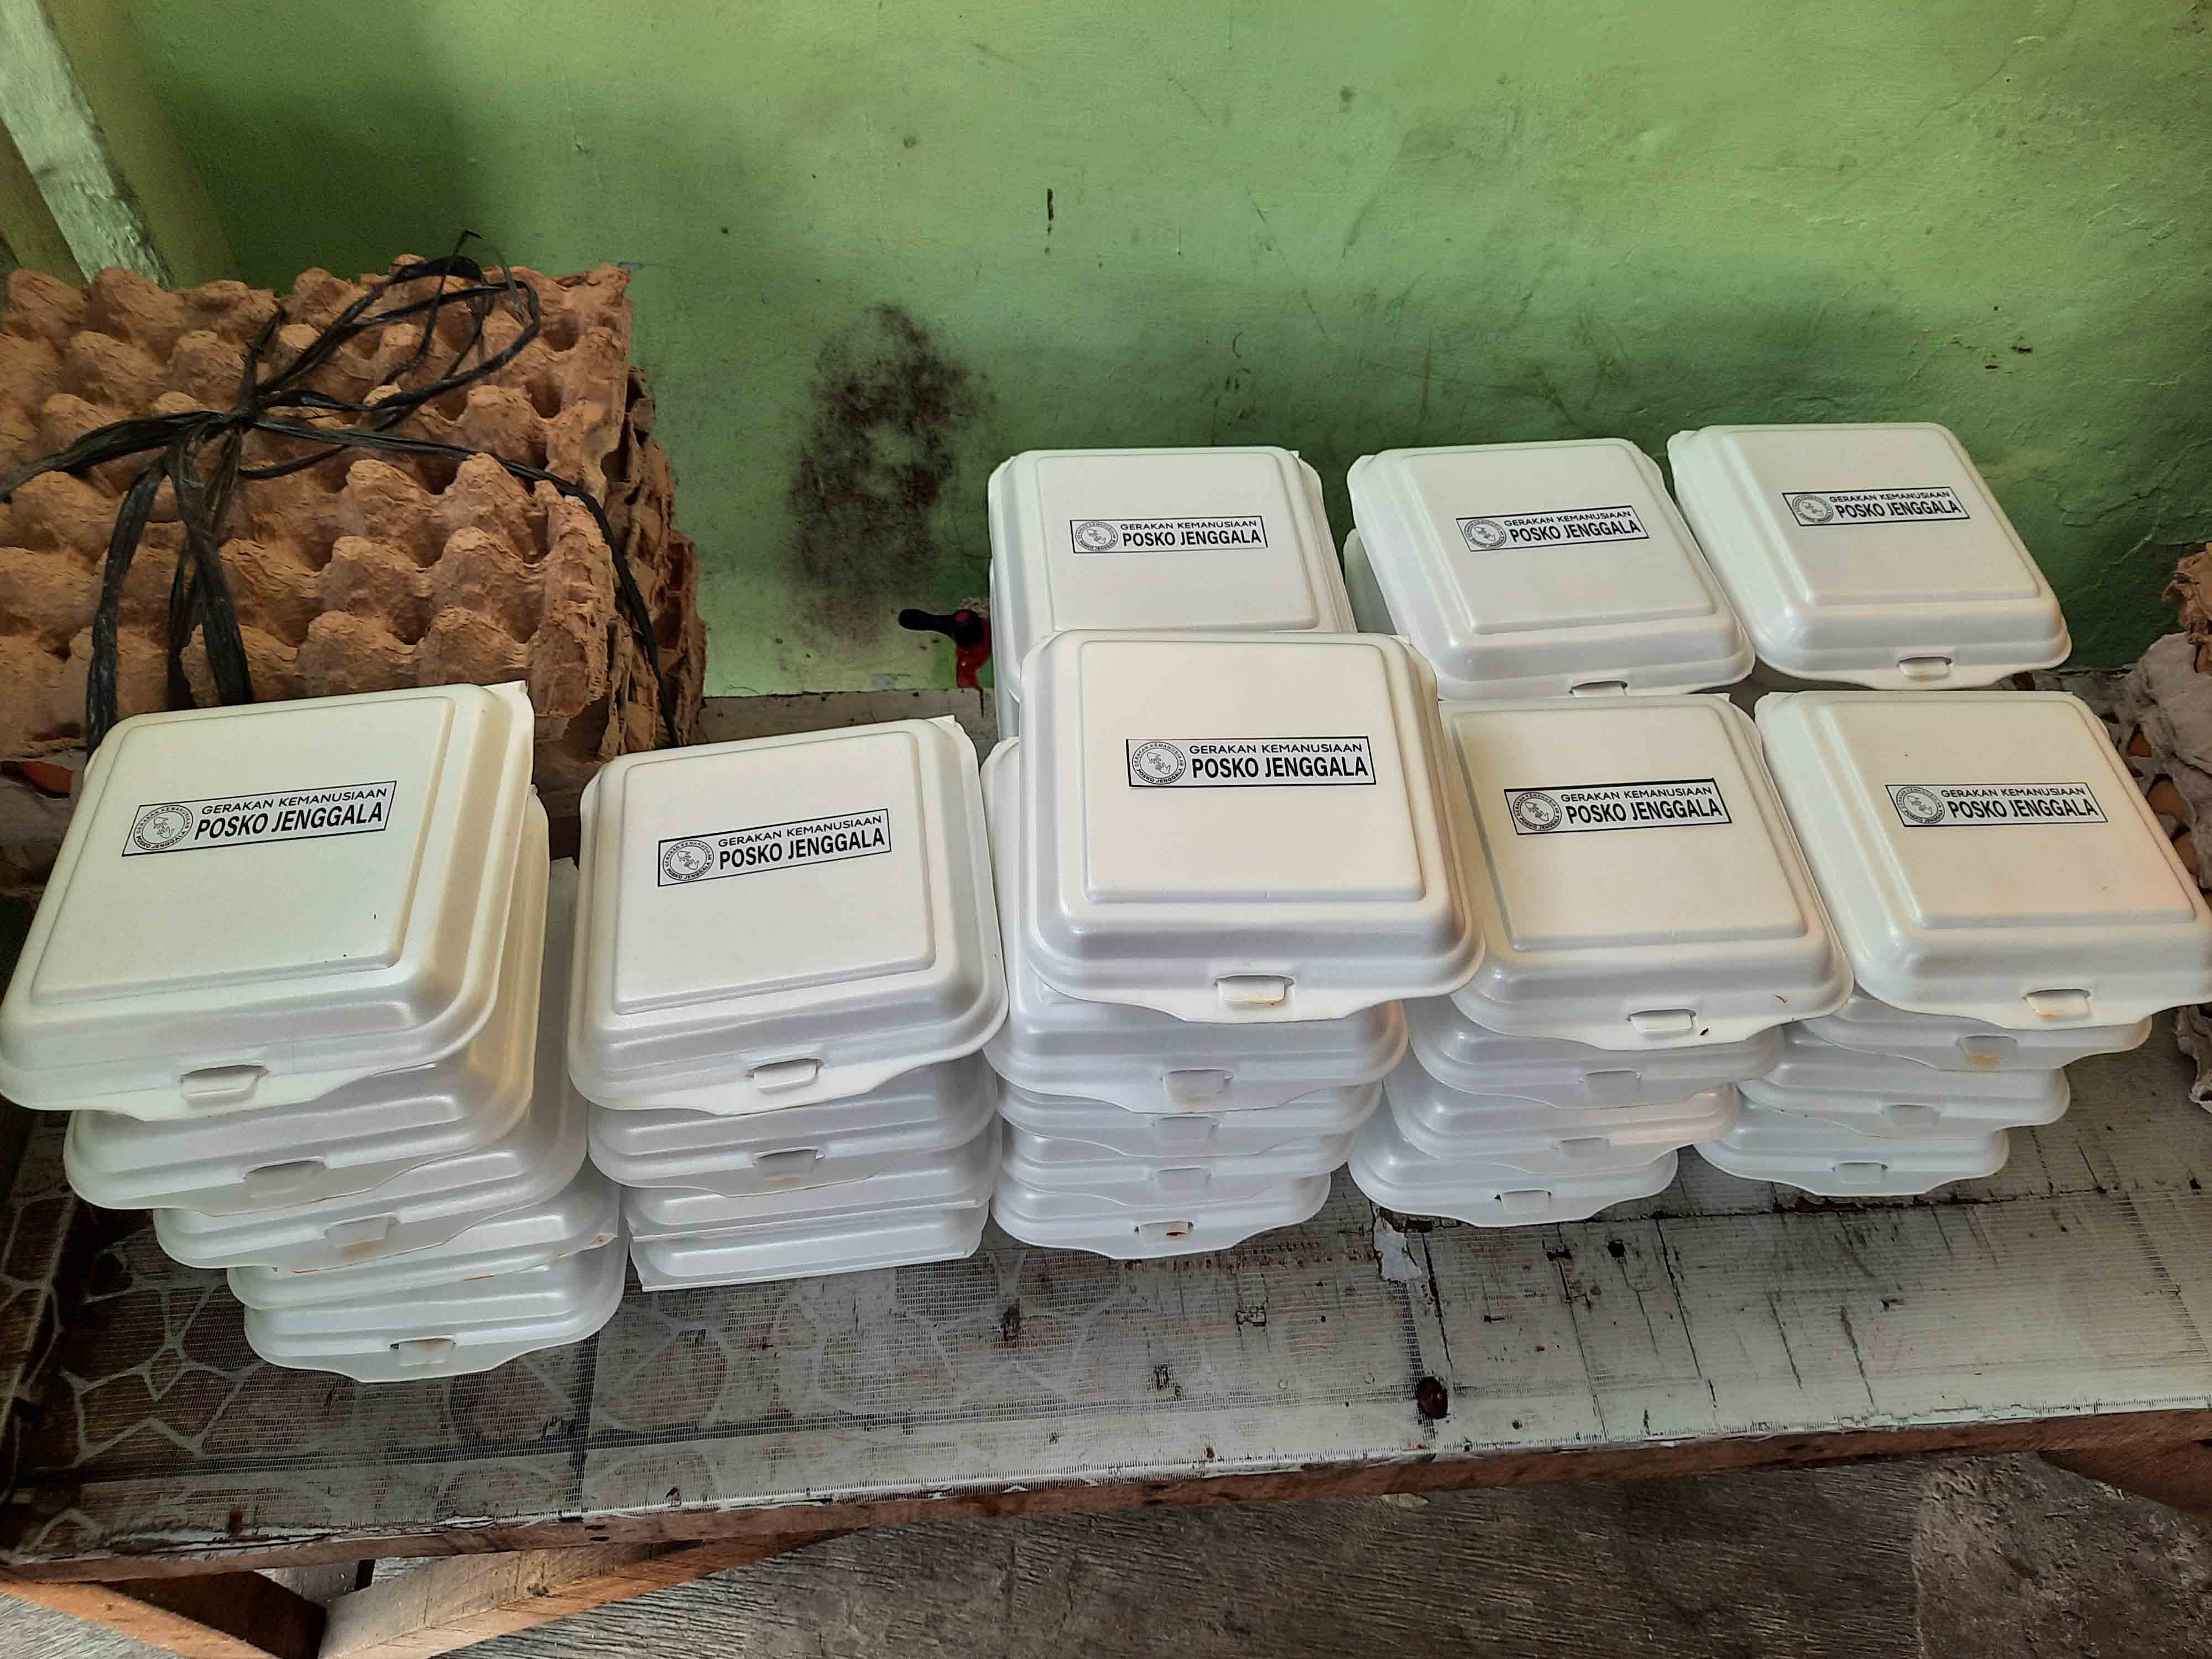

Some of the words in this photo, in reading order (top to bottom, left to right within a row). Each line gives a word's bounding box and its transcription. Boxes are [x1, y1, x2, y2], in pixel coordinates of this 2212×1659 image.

[1829, 494, 1876, 503] GERAKAN
[1879, 491, 1950, 500] KEMANUSIAAN
[1835, 503, 1885, 518] POSKO
[1886, 500, 1962, 516] JENGGALA
[1177, 520, 1257, 529] KEMANUSIAAN
[1504, 517, 1554, 526] GERAKAN
[1557, 511, 1631, 522] KEMANUSIAAN
[1123, 531, 1176, 546] POSKO
[1180, 529, 1261, 546] JENGGALA
[1509, 526, 1561, 542] POSKO
[1566, 520, 1641, 539] JENGGALA
[1189, 745, 1256, 754] GERAKAN
[1262, 743, 1362, 753] KEMANUSIAAN
[1192, 758, 1259, 778] POSKO
[1265, 757, 1369, 778] JENGGALA
[201, 799, 274, 815] GERAKAN
[279, 788, 387, 807] KEMANUSIAAN
[1561, 792, 1620, 802] GERAKAN
[1624, 787, 1712, 800] KEMANUSIAAN
[1940, 789, 1997, 797] GERAKAN
[2001, 788, 2085, 796] KEMANUSIAAN
[1566, 803, 1626, 824] POSKO
[1631, 798, 1722, 821] JENGGALA
[1947, 800, 2007, 818] POSKO
[2010, 799, 2098, 817] JENGGALA
[195, 813, 269, 840] POSKO
[272, 802, 382, 833] JENGGALA
[718, 832, 782, 847] GERAKAN
[787, 816, 881, 837] KEMANUSIAAN
[720, 843, 782, 869] POSKO
[788, 828, 885, 859] JENGGALA
